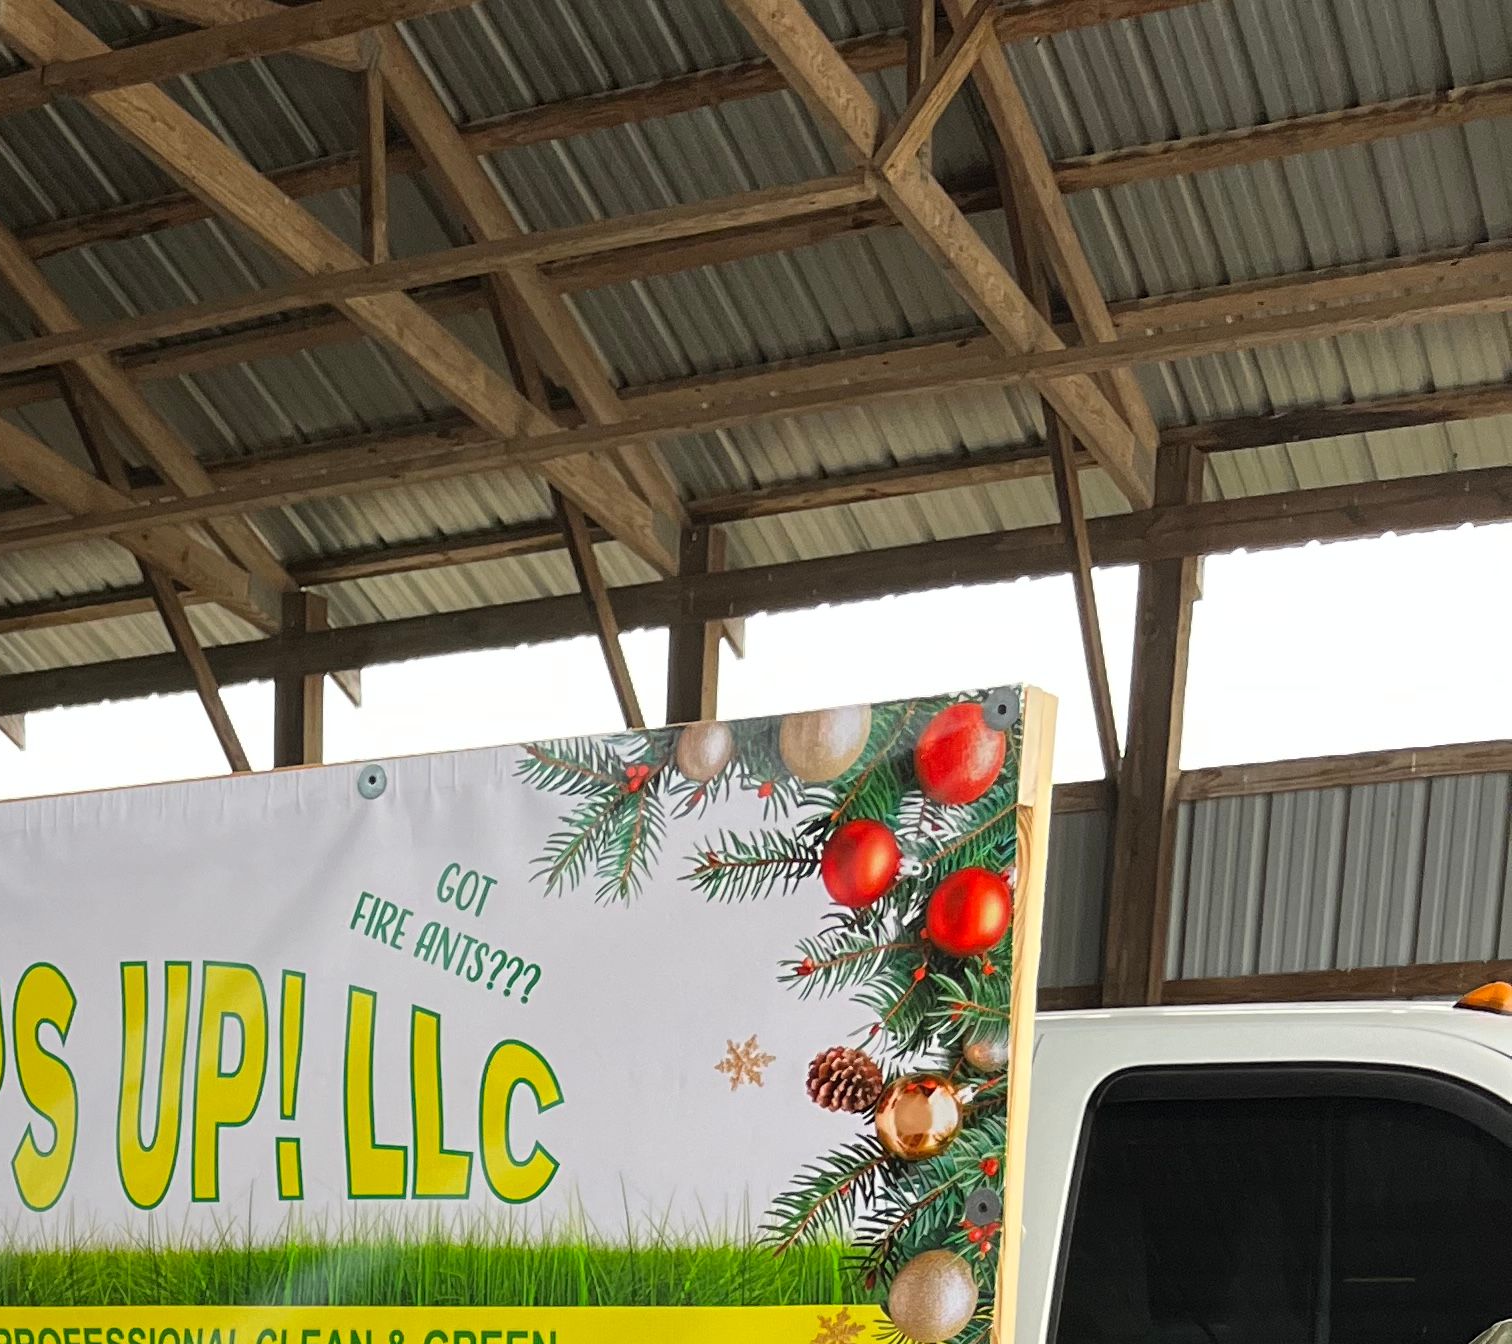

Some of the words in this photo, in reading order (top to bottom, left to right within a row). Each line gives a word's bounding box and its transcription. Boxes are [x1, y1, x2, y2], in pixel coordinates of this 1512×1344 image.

[350, 890, 417, 953] FIRE
[412, 920, 544, 1006] ANTS???
[435, 861, 498, 920] GOT
[116, 960, 307, 1210] UP!
[344, 984, 565, 1206] LLC
